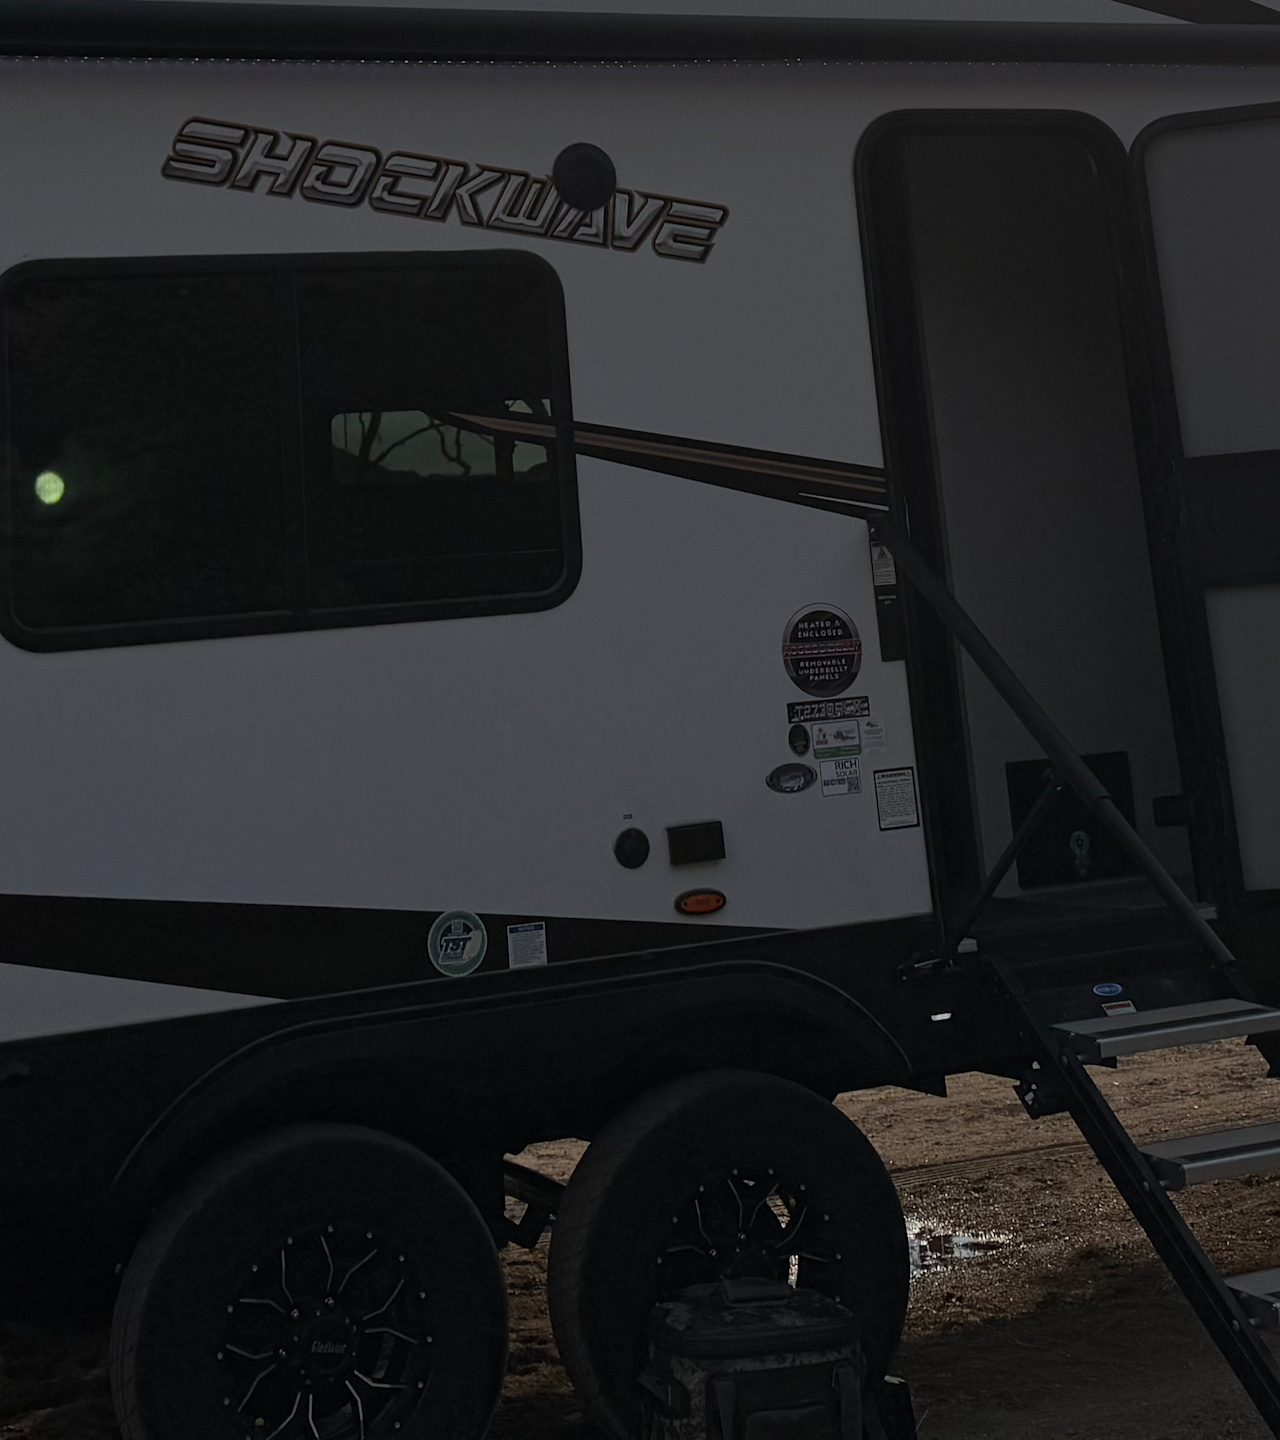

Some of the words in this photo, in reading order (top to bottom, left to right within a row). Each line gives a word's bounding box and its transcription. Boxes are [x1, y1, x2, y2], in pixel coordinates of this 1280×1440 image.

[161, 115, 730, 264] SHOCKWAVE
[798, 620, 831, 630] HEATED
[797, 628, 844, 639] ENCLOSED
[799, 658, 847, 668] REMOVABLE
[798, 665, 849, 676] UNDERBELLY
[809, 672, 840, 681] PANELS
[835, 759, 858, 771] RICH
[835, 769, 859, 778] SOLAR
